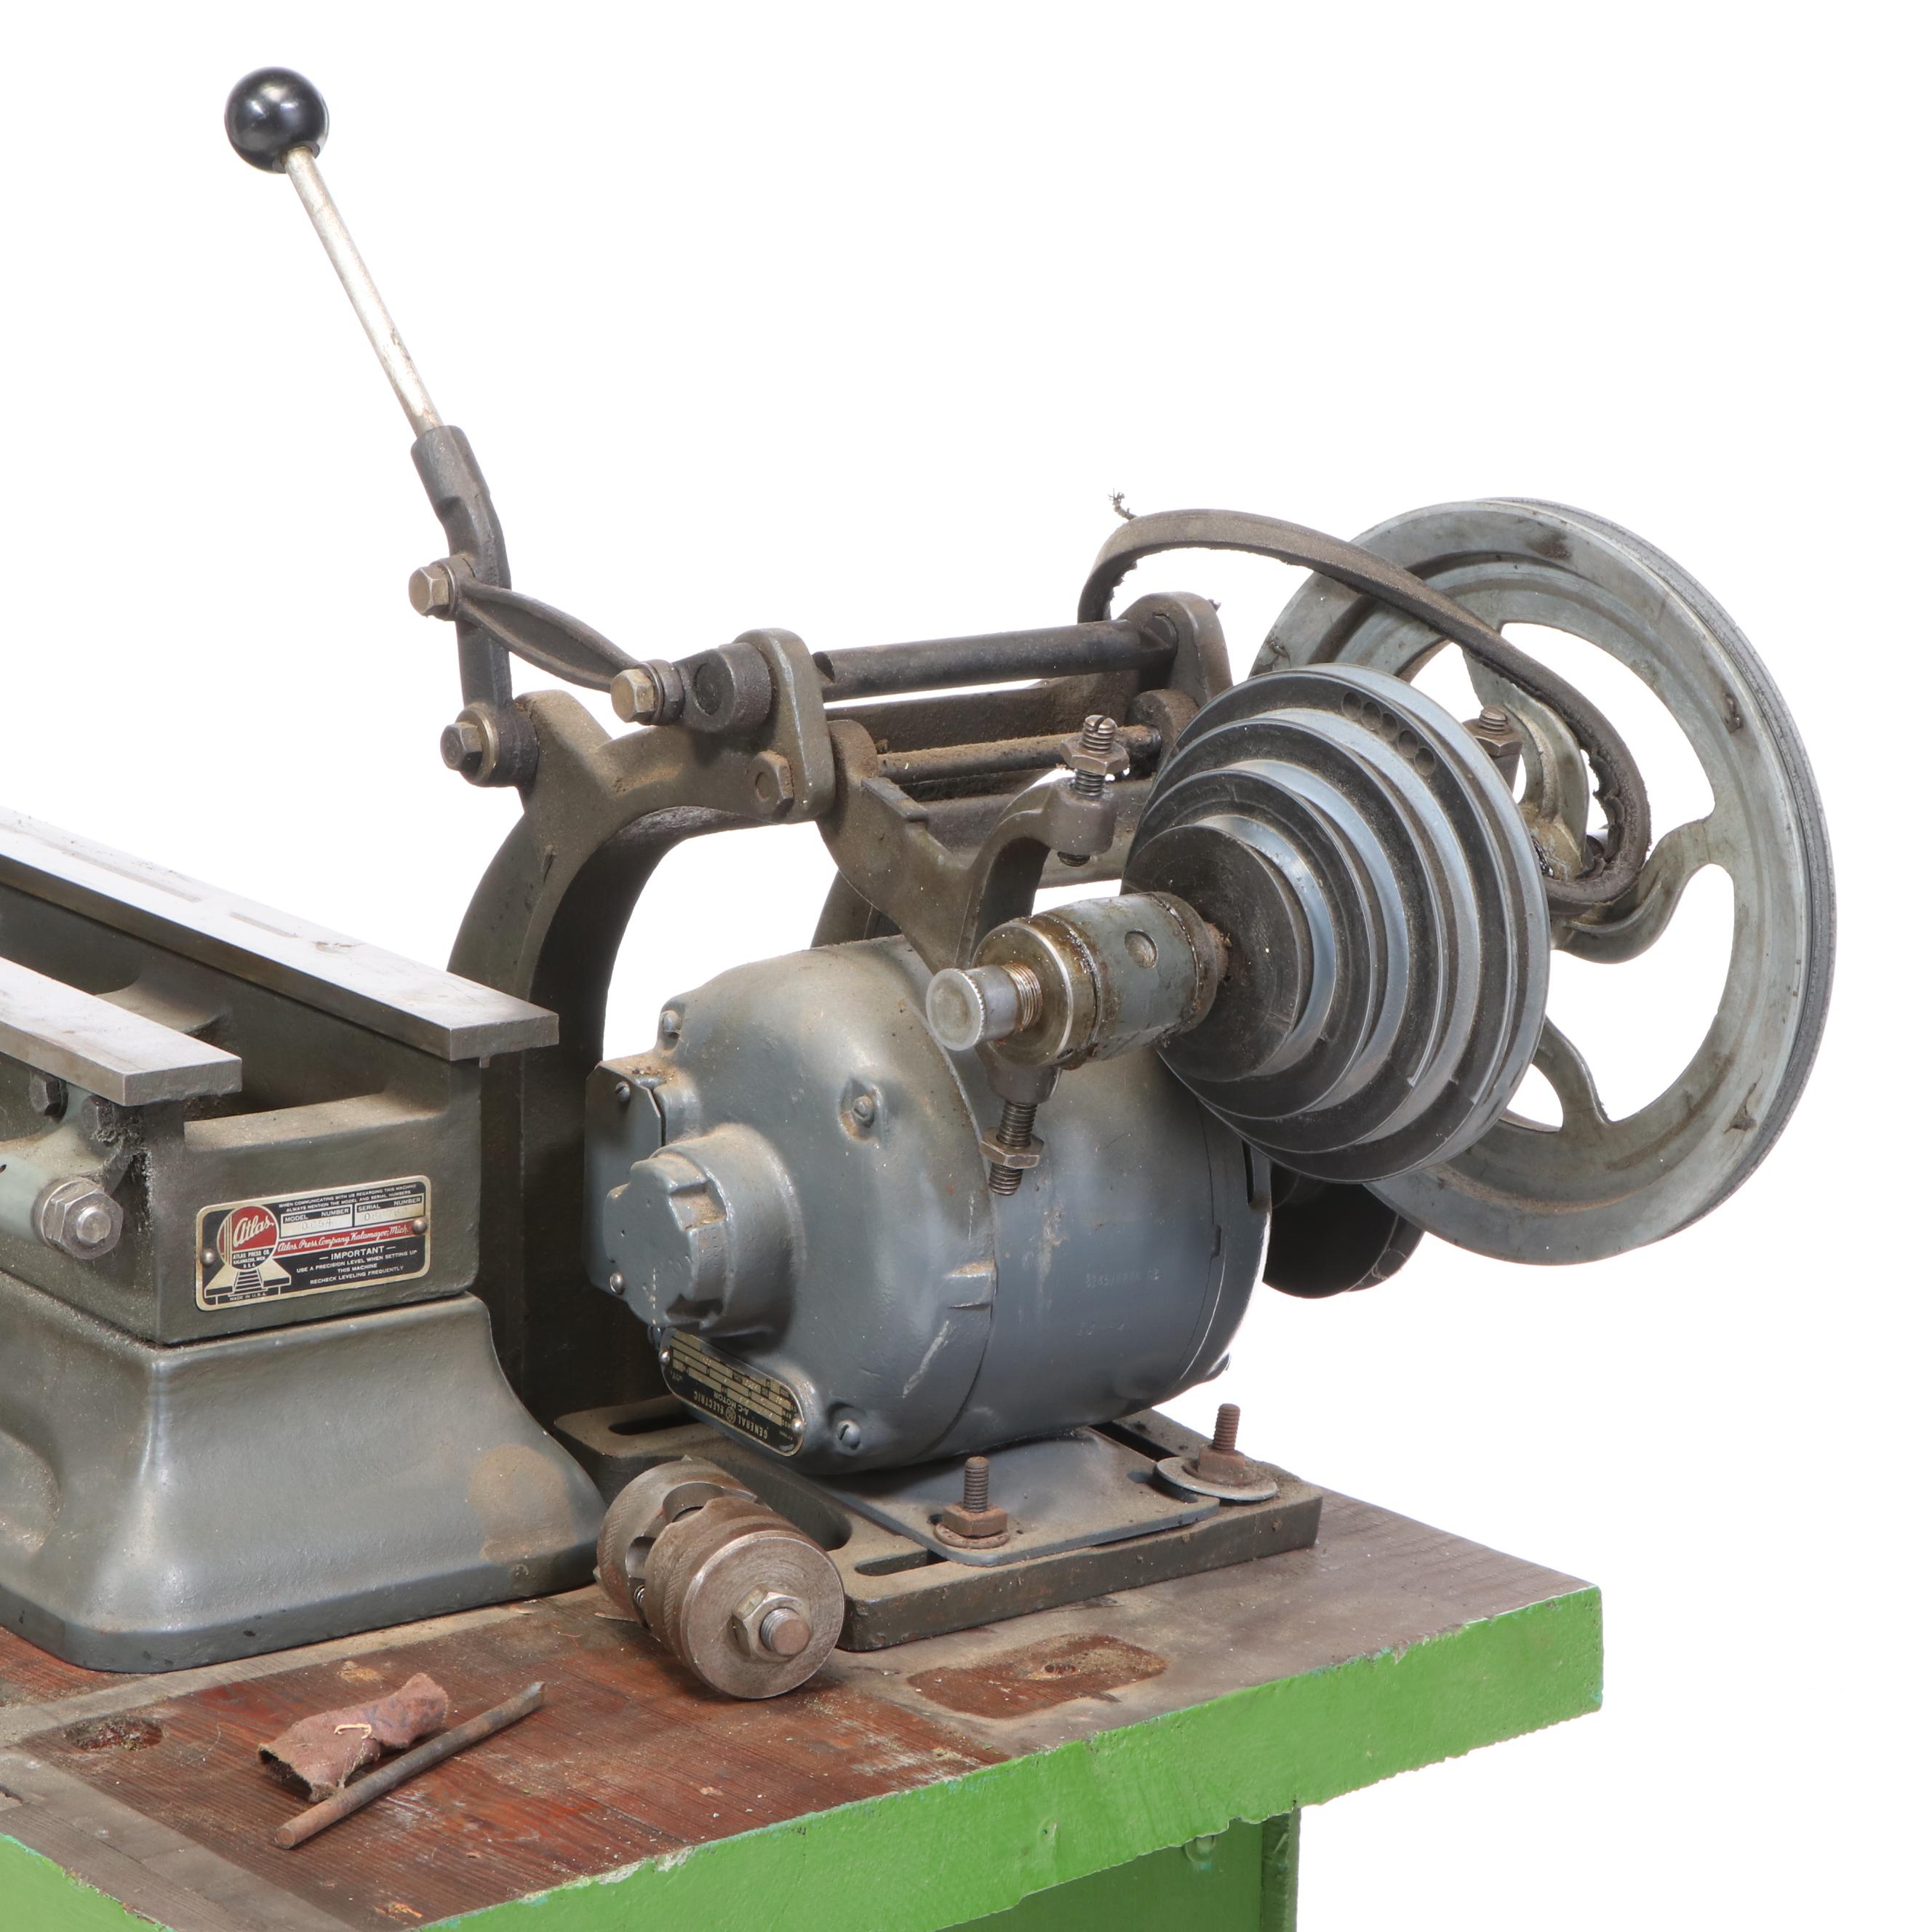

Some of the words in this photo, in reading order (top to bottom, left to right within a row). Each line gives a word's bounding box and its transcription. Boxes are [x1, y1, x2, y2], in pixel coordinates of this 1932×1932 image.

[286, 1205, 306, 1213] ALWAYS
[307, 1202, 330, 1210] MENTION
[341, 1197, 357, 1205] MODEL
[371, 1192, 388, 1200] SERIAL
[388, 1189, 411, 1198] NUMBERS
[294, 1195, 335, 1207] COMMUNICATING
[356, 1189, 383, 1197] REGARDING
[396, 1183, 417, 1191] MACHINE
[358, 1203, 380, 1212] SERIAL
[394, 1197, 421, 1207] NUMBER
[284, 1213, 308, 1223] MODEL
[321, 1208, 349, 1217] NUMBER
[233, 1216, 274, 1248] Atlas
[315, 1261, 346, 1270] PRECISION
[346, 1258, 366, 1266] LEVEL
[366, 1255, 384, 1263] WHEN
[384, 1250, 408, 1260] SETTING
[331, 1246, 385, 1261] IMPORTANT
[310, 1276, 337, 1285] RECHECK
[338, 1272, 367, 1281] LEVELING
[367, 1265, 404, 1277] FREQUENTLY
[351, 1263, 378, 1272] MACHINE
[693, 1390, 724, 1415] ELECTRIC
[713, 1391, 738, 1408] MOTOR
[737, 1405, 749, 1416] A-C
[738, 1419, 768, 1440] GENERAL
